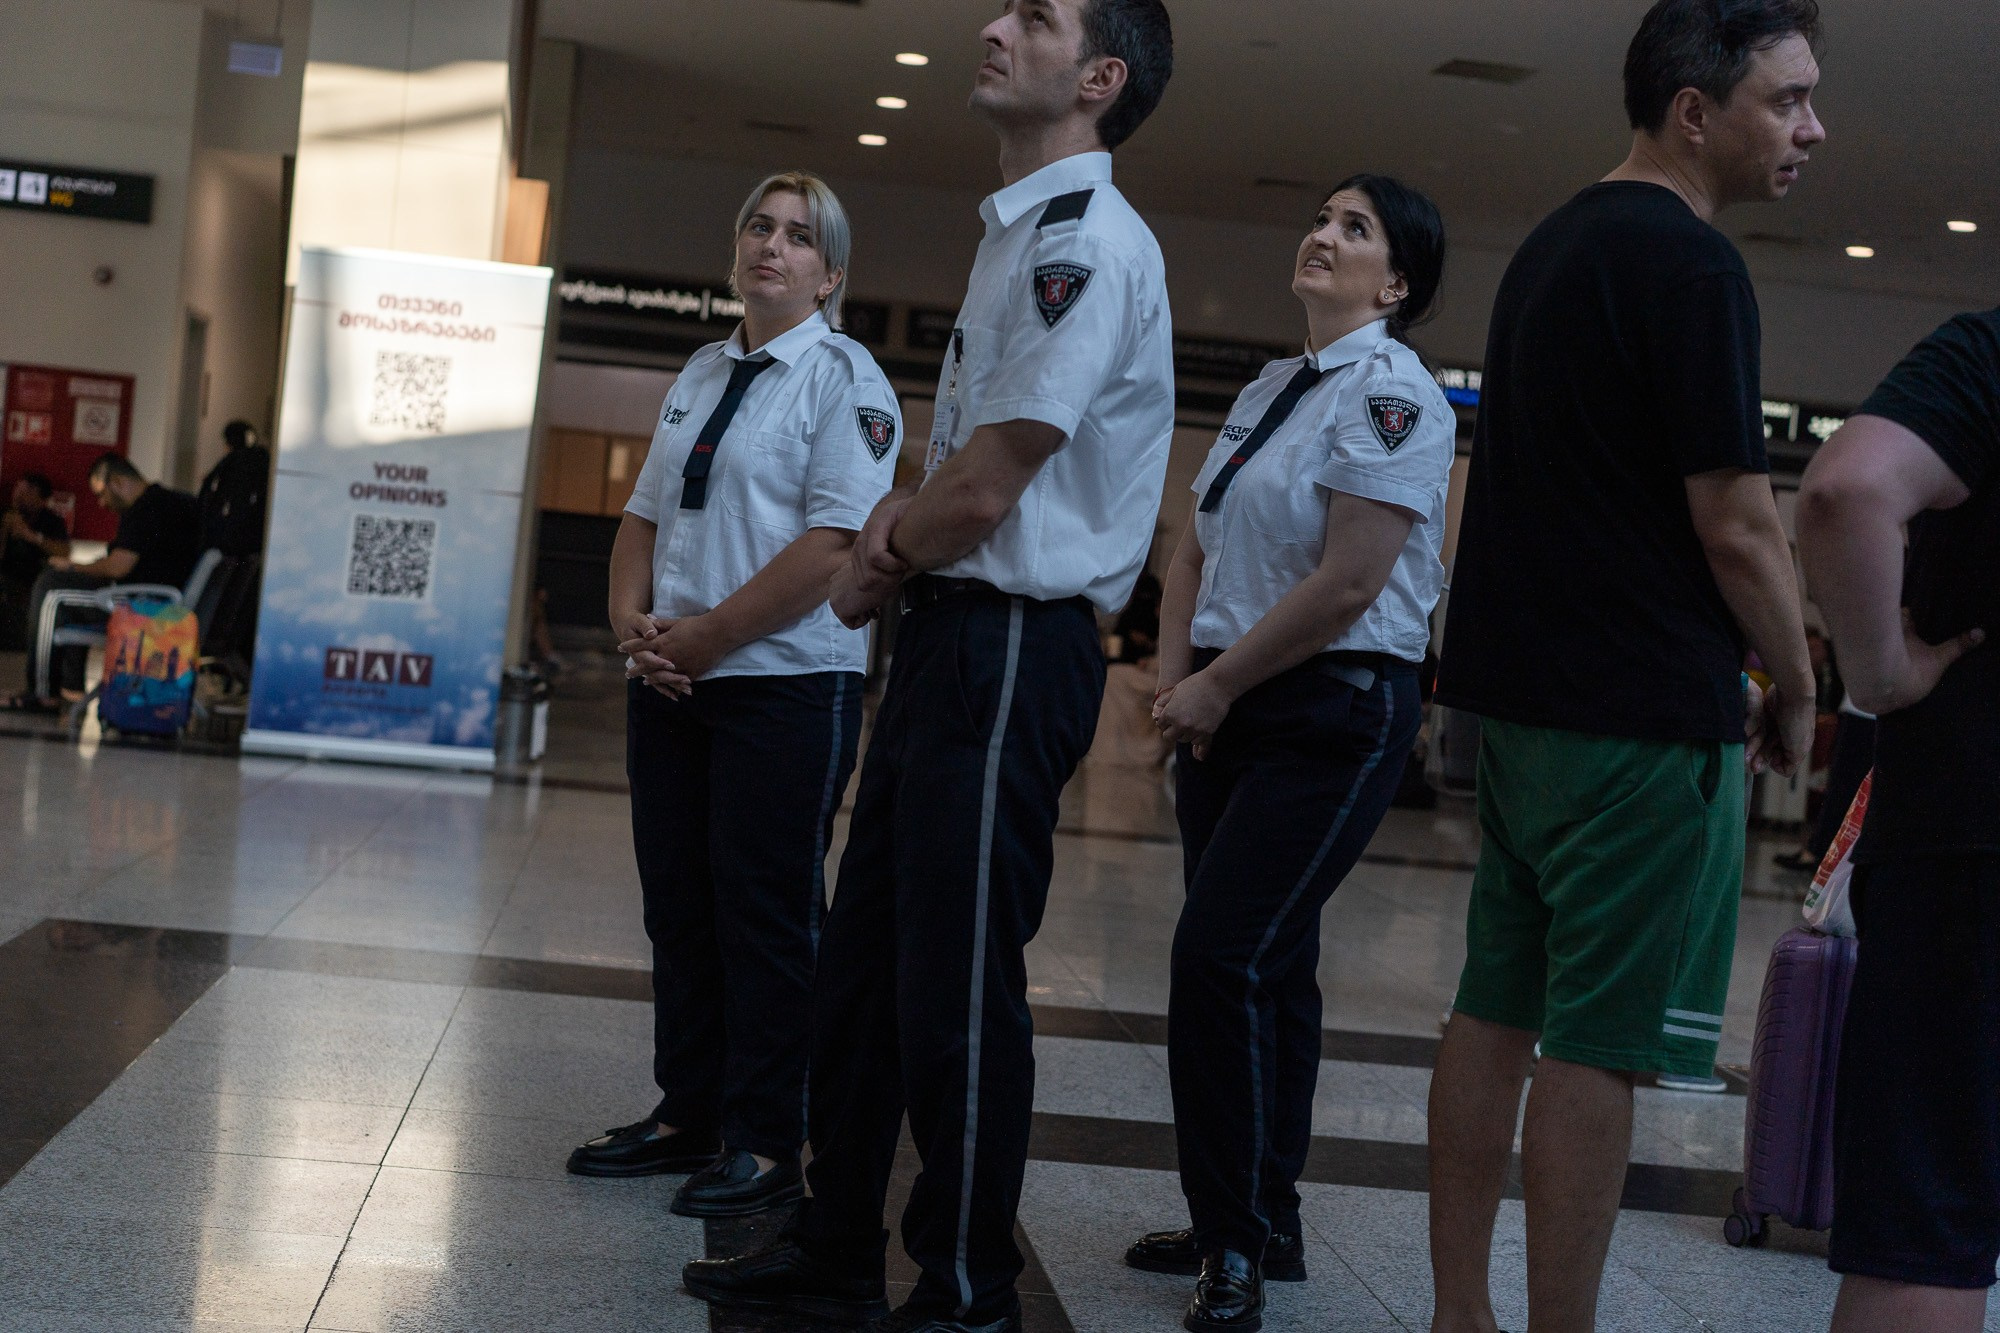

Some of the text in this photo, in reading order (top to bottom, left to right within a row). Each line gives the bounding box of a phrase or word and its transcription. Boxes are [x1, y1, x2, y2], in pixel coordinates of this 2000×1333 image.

[664, 413, 683, 425] LICE
[373, 461, 429, 483] YOUR
[349, 481, 448, 508] OPINIONS
[328, 650, 429, 684] TAV
